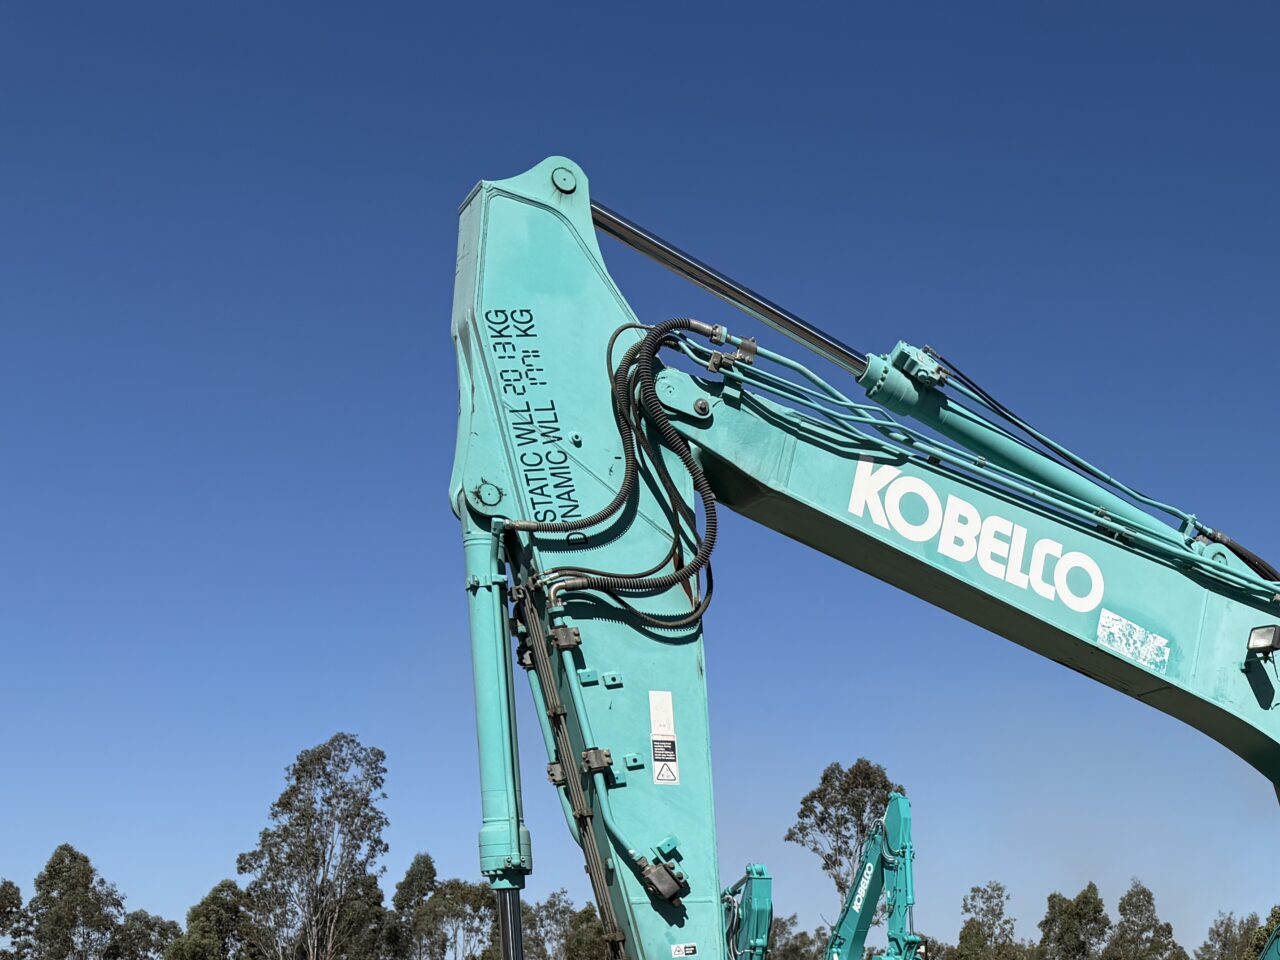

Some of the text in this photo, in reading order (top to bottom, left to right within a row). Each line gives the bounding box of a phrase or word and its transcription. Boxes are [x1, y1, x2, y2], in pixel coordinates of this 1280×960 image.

[510, 308, 538, 338] KG
[508, 400, 538, 447] WLL
[533, 399, 563, 445] WLL
[520, 452, 557, 523] STATIC
[544, 450, 589, 546] DNAMIC
[847, 454, 1105, 613] KOBELCO
[852, 862, 874, 913] KOBELCO
